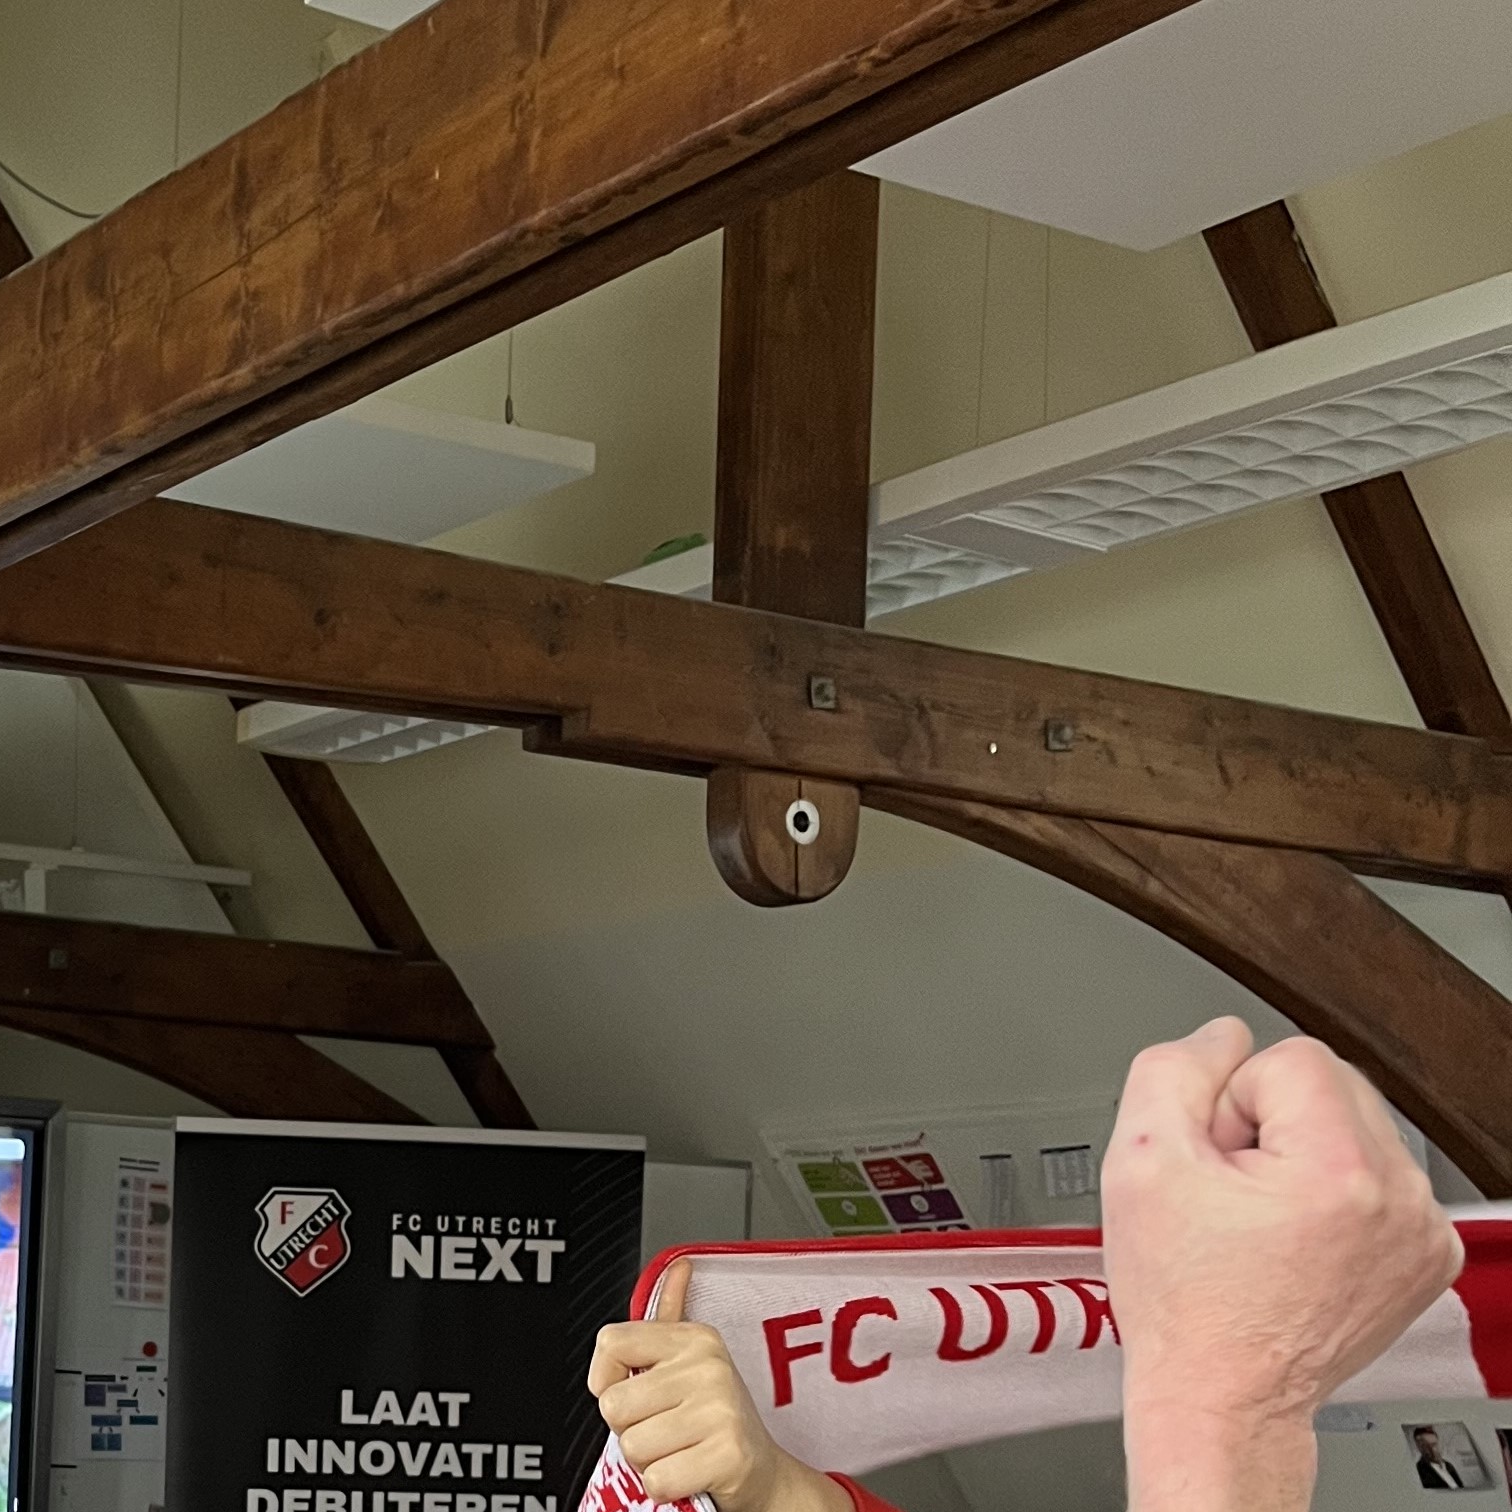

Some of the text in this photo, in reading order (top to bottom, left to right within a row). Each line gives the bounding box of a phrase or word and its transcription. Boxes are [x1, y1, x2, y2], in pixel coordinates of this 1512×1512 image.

[280, 1201, 294, 1225] F
[392, 1213, 557, 1236] FC UTRECHT
[269, 1199, 340, 1271] UTRECHT
[308, 1245, 329, 1269] C
[391, 1234, 566, 1283] NEXT
[763, 1295, 898, 1408] FC
[341, 1389, 470, 1427] LAAT
[267, 1438, 543, 1480] INNOVATIE
